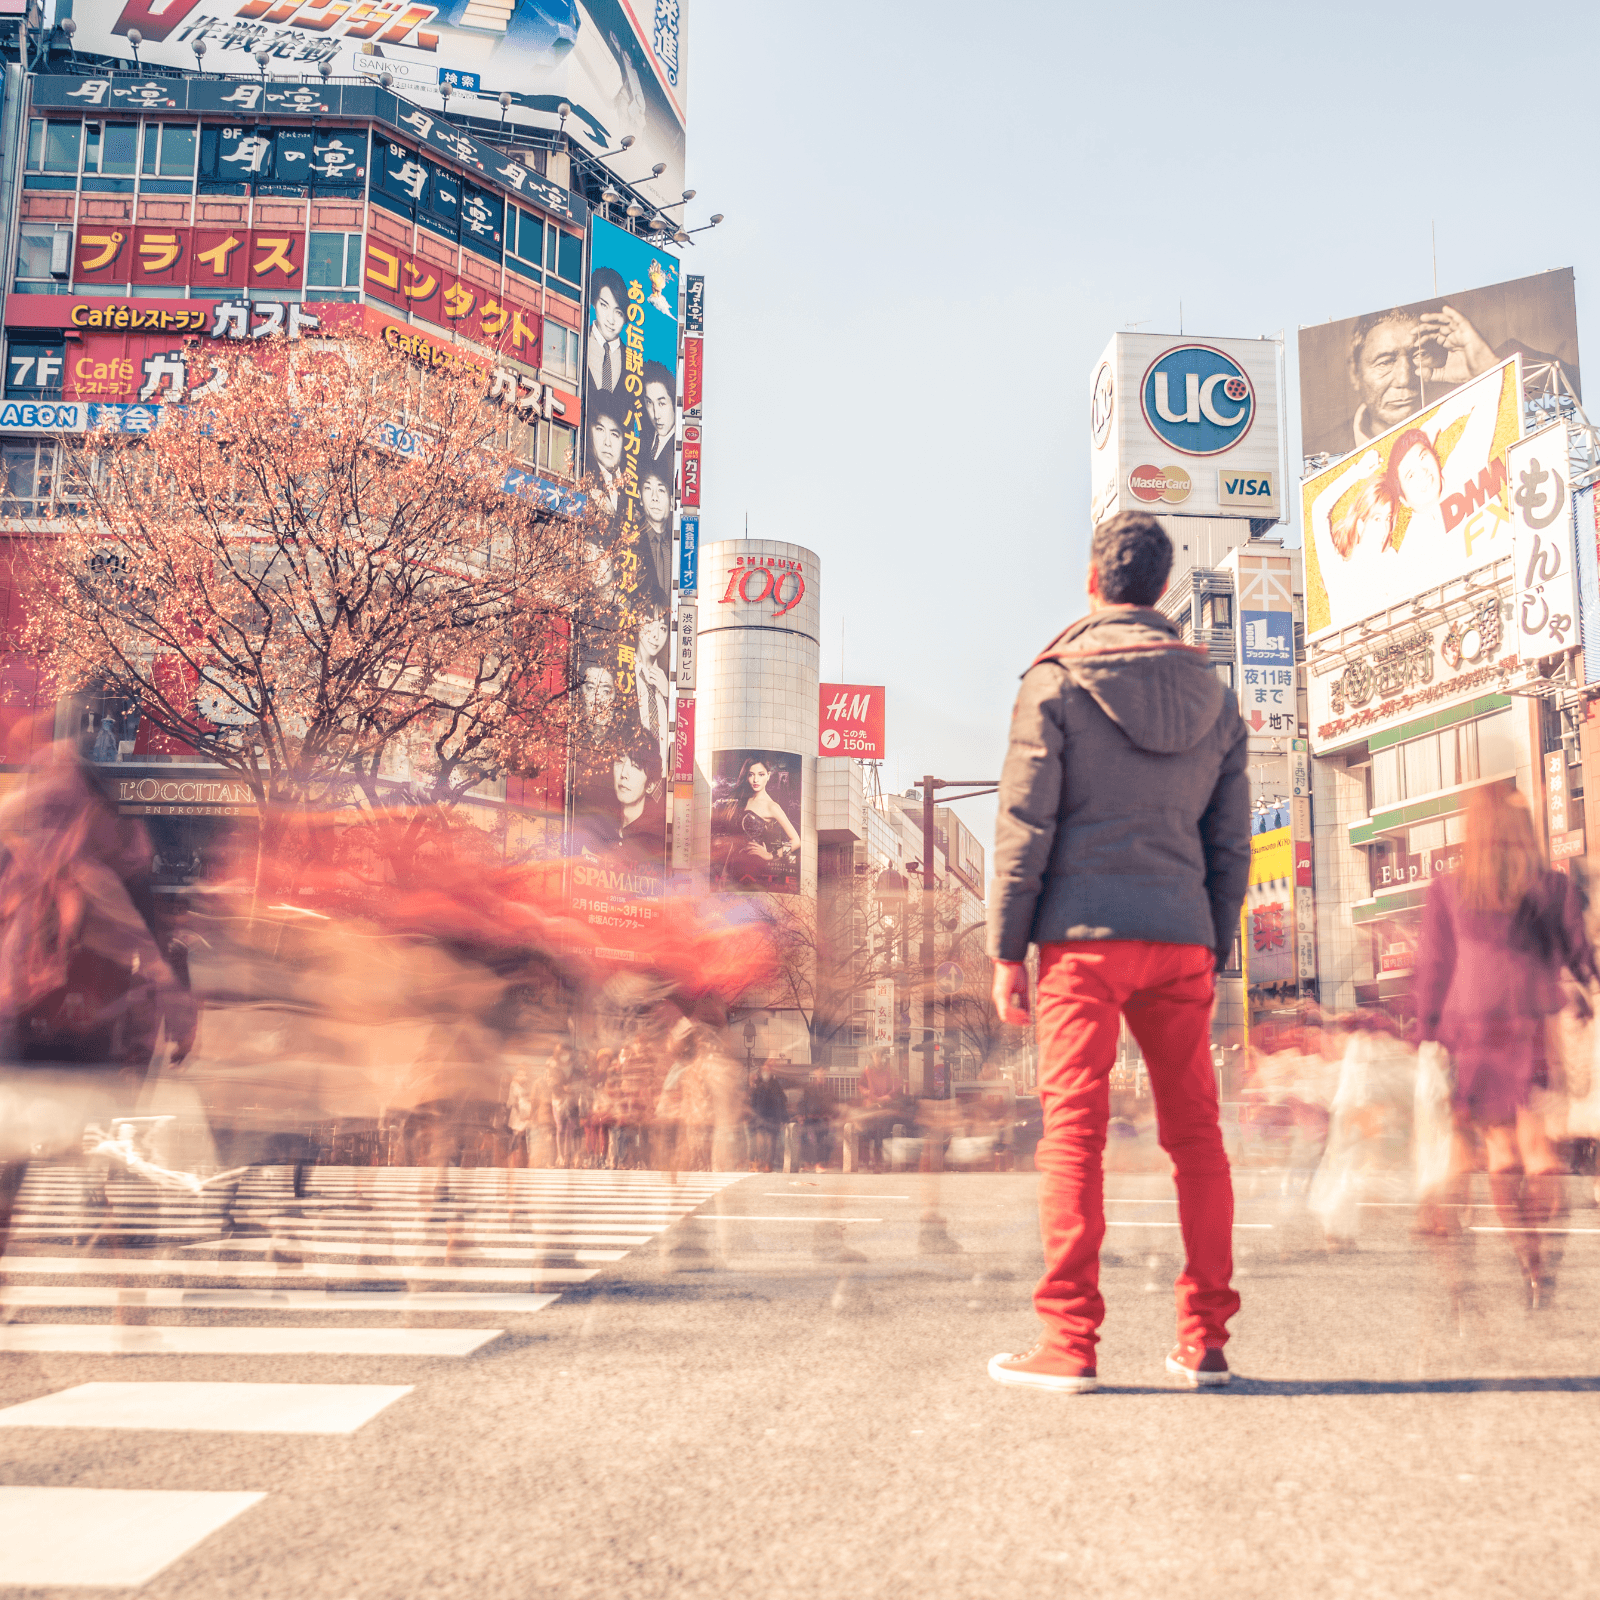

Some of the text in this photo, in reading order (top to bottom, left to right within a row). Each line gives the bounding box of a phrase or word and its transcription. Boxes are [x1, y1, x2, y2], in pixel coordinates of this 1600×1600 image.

[176, 15, 343, 64] 作戦発動
[359, 58, 409, 76] SANKYO
[444, 71, 475, 89] 検索
[66, 80, 169, 107] 月の宴
[220, 84, 322, 112] 月の宴
[222, 128, 243, 139] 9F
[400, 111, 479, 164] 月の宴
[220, 136, 356, 177] 月の宴
[389, 143, 407, 159] 9F
[388, 161, 494, 235] 月の宴
[496, 163, 569, 213] 月の宴
[80, 232, 296, 275] プライス
[366, 245, 537, 348] コンタクト
[212, 299, 319, 338] ガスト
[11, 356, 63, 386] 7F
[75, 357, 134, 380] Café
[687, 339, 699, 405] プライス コンタクト
[76, 382, 132, 396] レストラン
[489, 365, 567, 420] ガスト
[2, 403, 79, 427] AEON
[690, 408, 701, 416] 8F
[685, 459, 698, 498] ガスト
[1131, 476, 1191, 491] MasterCard
[1224, 478, 1272, 497] VISA
[1439, 456, 1509, 534] DMM
[1515, 457, 1572, 644] もんじゃ
[736, 556, 803, 573] SHIBUYA
[717, 566, 806, 617] 109
[682, 613, 693, 681] 渋谷駅前ビル
[1246, 651, 1290, 659] ブックファースト
[1244, 669, 1292, 686] 夜11時
[678, 699, 694, 708] 5F
[827, 692, 871, 723] H&M
[1255, 688, 1284, 704] まで
[843, 729, 867, 739] この先
[1269, 713, 1294, 731] 地下
[843, 739, 876, 751] 150m
[119, 778, 267, 803] L'OCCITAN
[145, 806, 240, 815] EN PROVENCE
[573, 865, 658, 896] SPAMALOT
[588, 914, 645, 929] 赤坂ACTシアター
[1252, 901, 1285, 952] 薬
